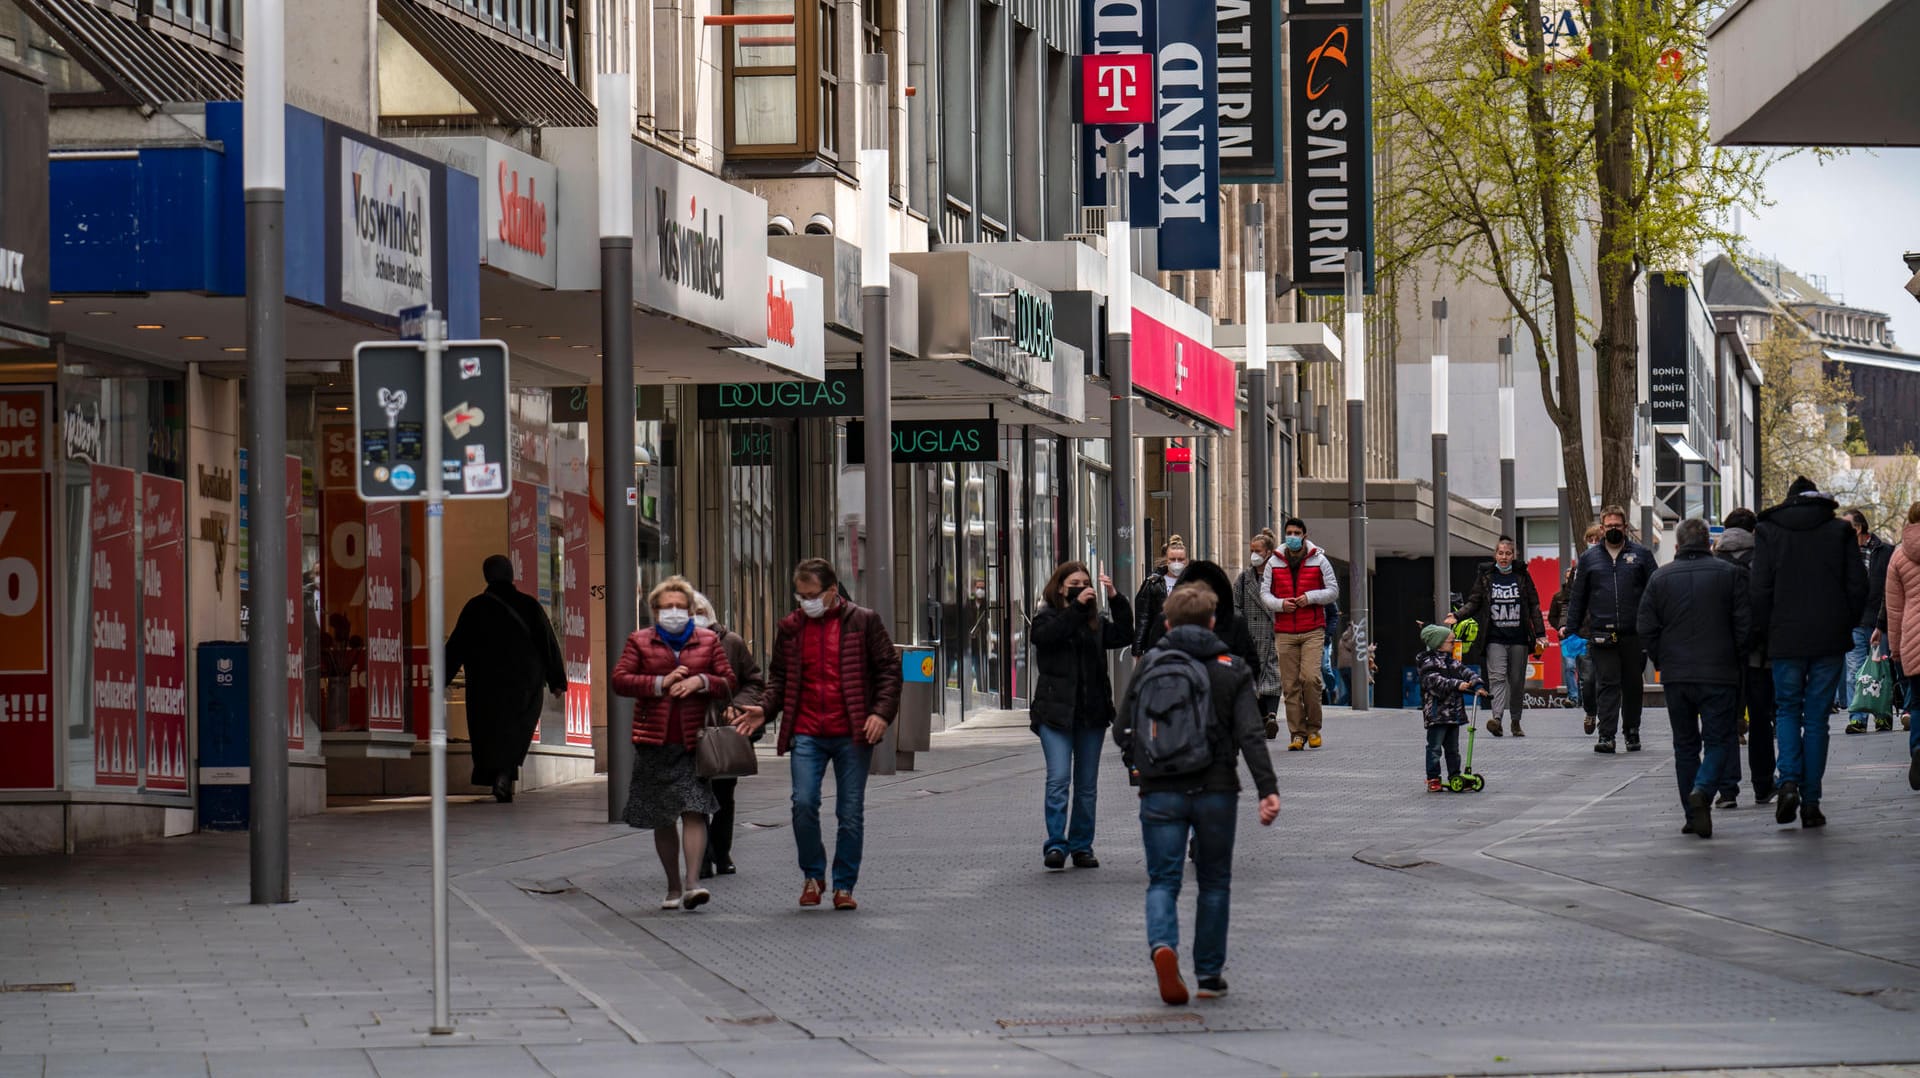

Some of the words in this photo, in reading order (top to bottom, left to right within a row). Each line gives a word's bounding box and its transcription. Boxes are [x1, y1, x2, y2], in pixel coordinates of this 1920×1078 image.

[1217, 0, 1252, 158] ATURN
[1159, 42, 1205, 223] KIND
[498, 160, 546, 257] Schuhe
[1306, 108, 1349, 274] SATURN
[352, 171, 422, 257] Voswinkel
[655, 186, 724, 301] Voswinkel
[1017, 288, 1054, 362] DOUGLAS
[719, 382, 847, 407] DOUGLAS
[0, 434, 36, 458] ort
[94, 551, 112, 591] Alle
[144, 559, 162, 598] Alle
[94, 610, 126, 651] Schuhe
[1490, 604, 1521, 622] SAM
[145, 617, 175, 658] Schuhe
[95, 670, 136, 711] reduziert
[145, 675, 185, 717] reduziert
